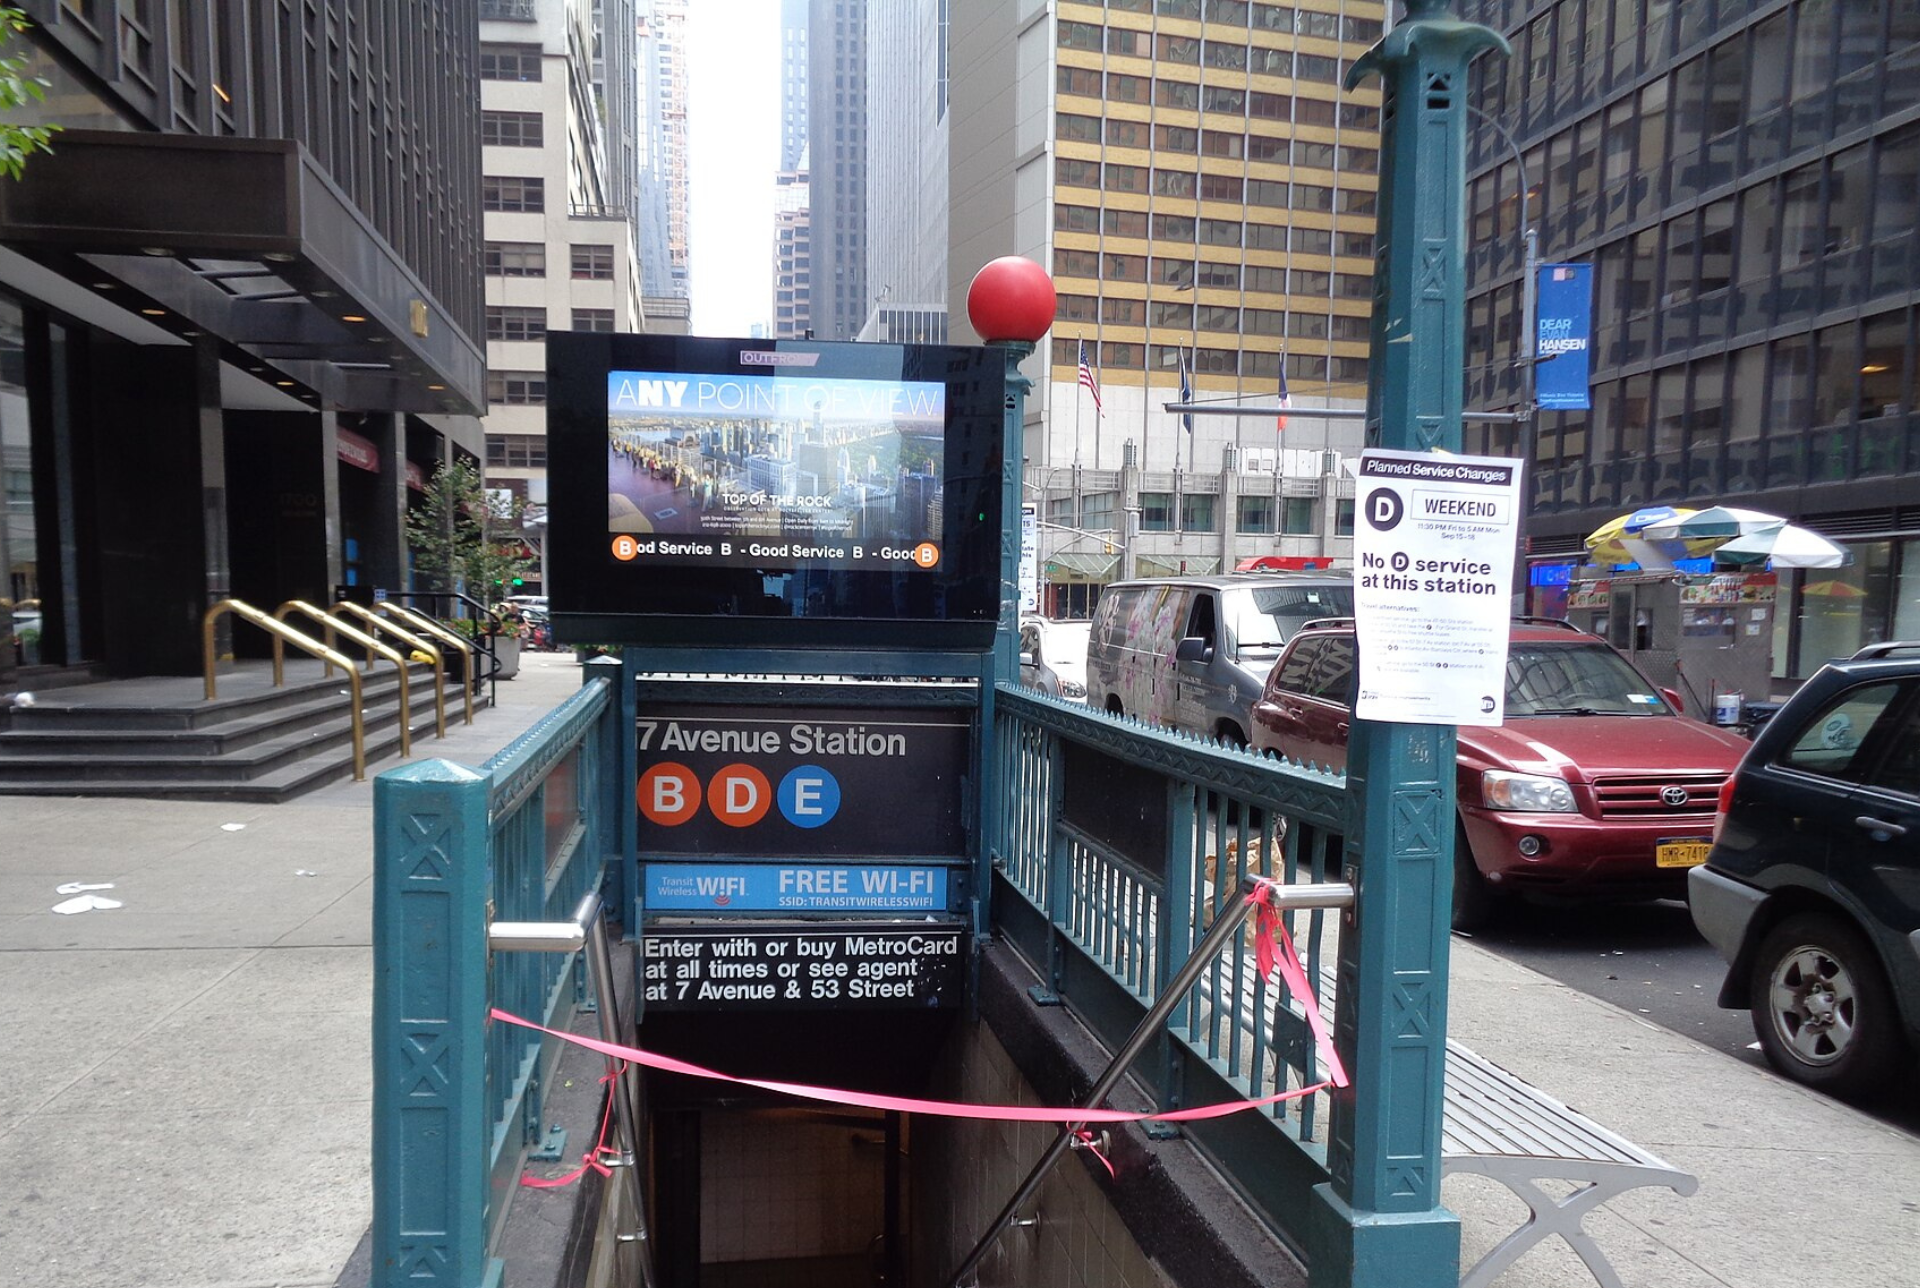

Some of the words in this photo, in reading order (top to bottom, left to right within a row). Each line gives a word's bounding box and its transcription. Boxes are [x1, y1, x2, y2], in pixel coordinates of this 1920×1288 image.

[1540, 319, 1572, 330] DEAR
[1540, 329, 1569, 339] EVAN
[1539, 339, 1586, 350] HANSEN
[616, 379, 688, 407] ANY
[699, 382, 797, 411] POINT
[804, 384, 847, 412] OF
[1367, 460, 1410, 475] Planned
[1412, 463, 1454, 478] Service
[1455, 466, 1506, 483] Changes
[722, 493, 747, 504] TOP
[750, 494, 767, 505] OF
[770, 495, 794, 506] THE
[795, 496, 832, 507] ROCK
[1374, 496, 1394, 522] D
[1425, 498, 1497, 517] WEEKEND
[1435, 523, 1447, 531] PM
[1441, 532, 1455, 540] Sep
[637, 541, 655, 554] od
[659, 541, 712, 555] Service
[721, 543, 732, 556] B
[750, 543, 788, 557] Good
[792, 544, 844, 558] Service
[852, 546, 863, 558] B
[1362, 552, 1385, 569] No
[1415, 558, 1492, 575] service
[1362, 573, 1379, 588] at
[1383, 574, 1418, 591] this
[1424, 577, 1496, 595] station
[636, 722, 657, 751] 7
[660, 722, 781, 754] Avenue
[789, 724, 906, 757] Station
[653, 776, 684, 812] B
[726, 777, 757, 814] D
[795, 778, 823, 815] E
[657, 887, 697, 896] Wireless
[662, 876, 693, 886] Transit
[779, 869, 848, 893] FREE
[861, 870, 934, 894] WI-FI
[778, 896, 807, 907] SSID:
[808, 896, 933, 907] TRANSITWIRELESSWIFI
[645, 938, 703, 957] Enter
[711, 937, 757, 957] with
[765, 941, 788, 957] or
[797, 937, 837, 960] buy
[845, 935, 957, 956] MetroCard
[645, 961, 667, 979] at
[676, 960, 700, 979] all
[708, 960, 768, 979] times
[777, 962, 800, 978] or
[808, 962, 848, 978] see
[857, 958, 918, 981] agent
[645, 982, 667, 1000] at
[675, 981, 690, 1000] 7
[697, 981, 776, 1000] Avenue
[785, 979, 801, 999] &
[810, 979, 840, 999] 53
[848, 978, 914, 998] Street
